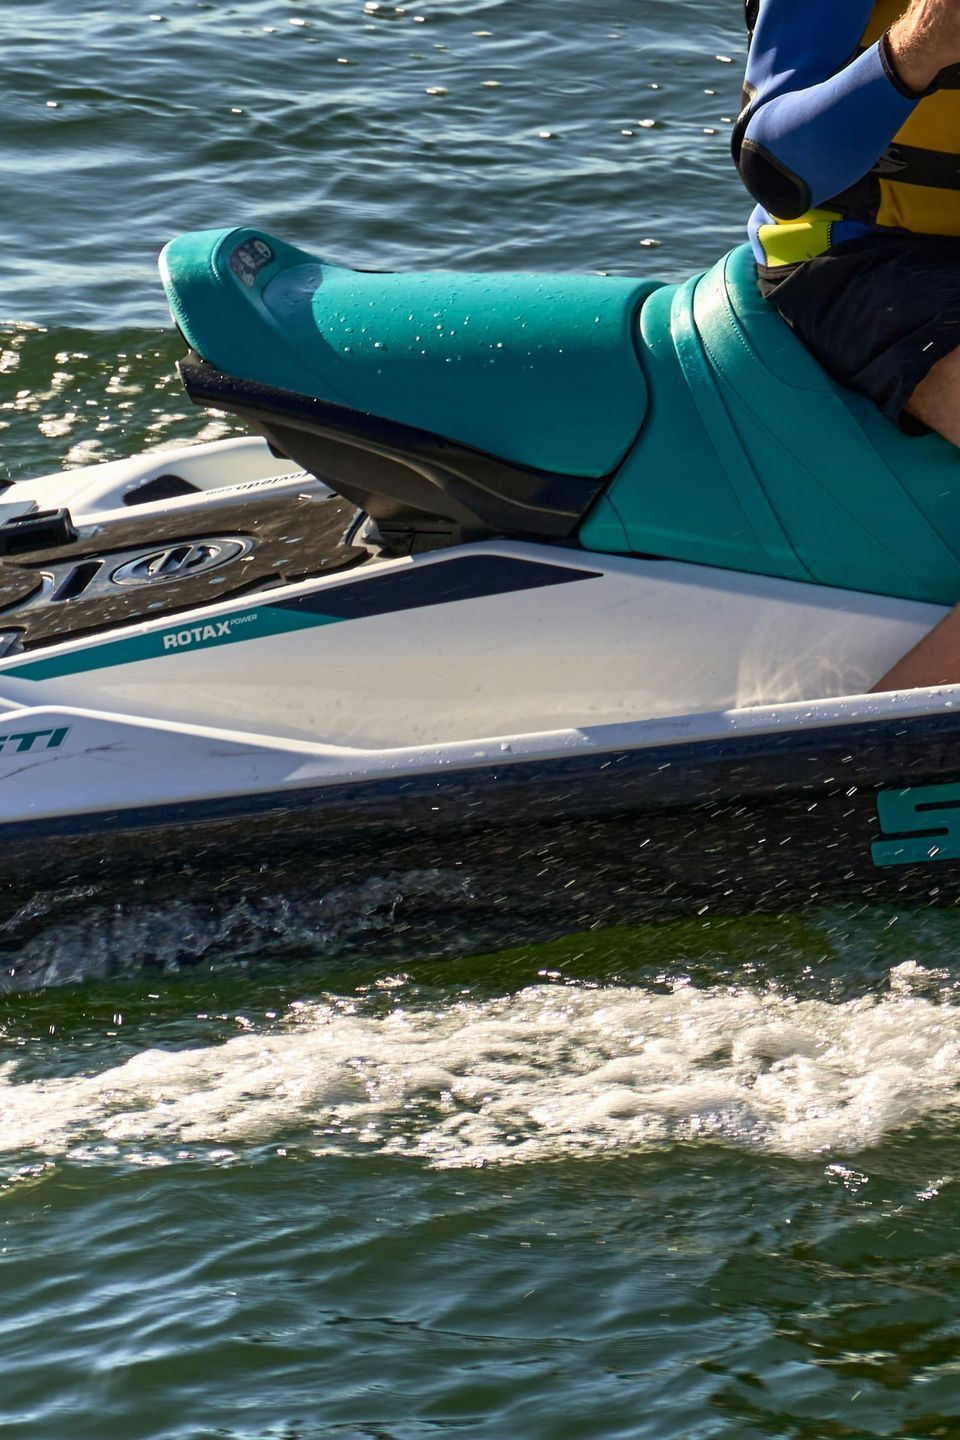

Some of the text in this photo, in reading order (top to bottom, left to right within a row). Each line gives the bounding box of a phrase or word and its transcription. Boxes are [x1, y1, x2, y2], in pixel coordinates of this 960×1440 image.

[163, 613, 258, 650] ROTAX POWER
[0, 726, 70, 752] TI
